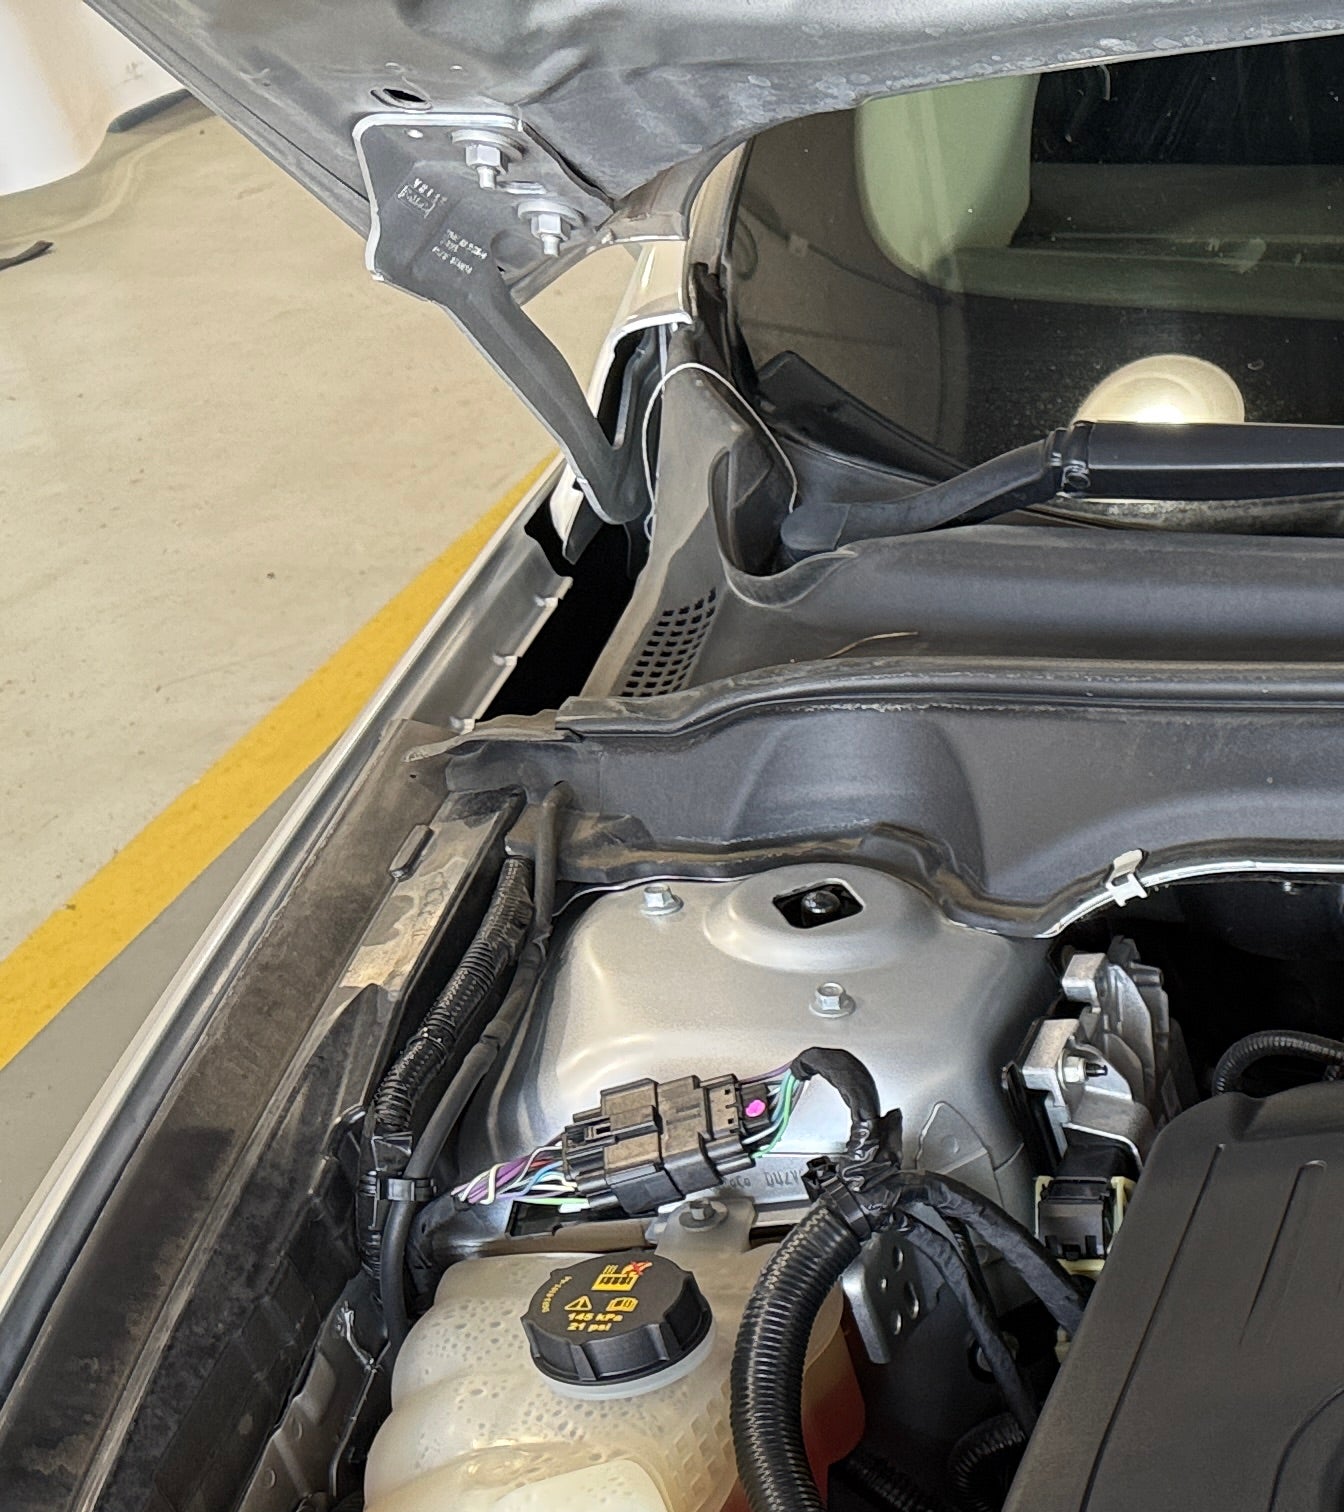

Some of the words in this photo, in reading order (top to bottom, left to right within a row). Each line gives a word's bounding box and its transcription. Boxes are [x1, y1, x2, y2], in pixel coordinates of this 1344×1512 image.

[568, 1312, 595, 1321] 145
[595, 1312, 624, 1322] kPa
[567, 1322, 587, 1331] 21
[587, 1322, 612, 1333] psi
